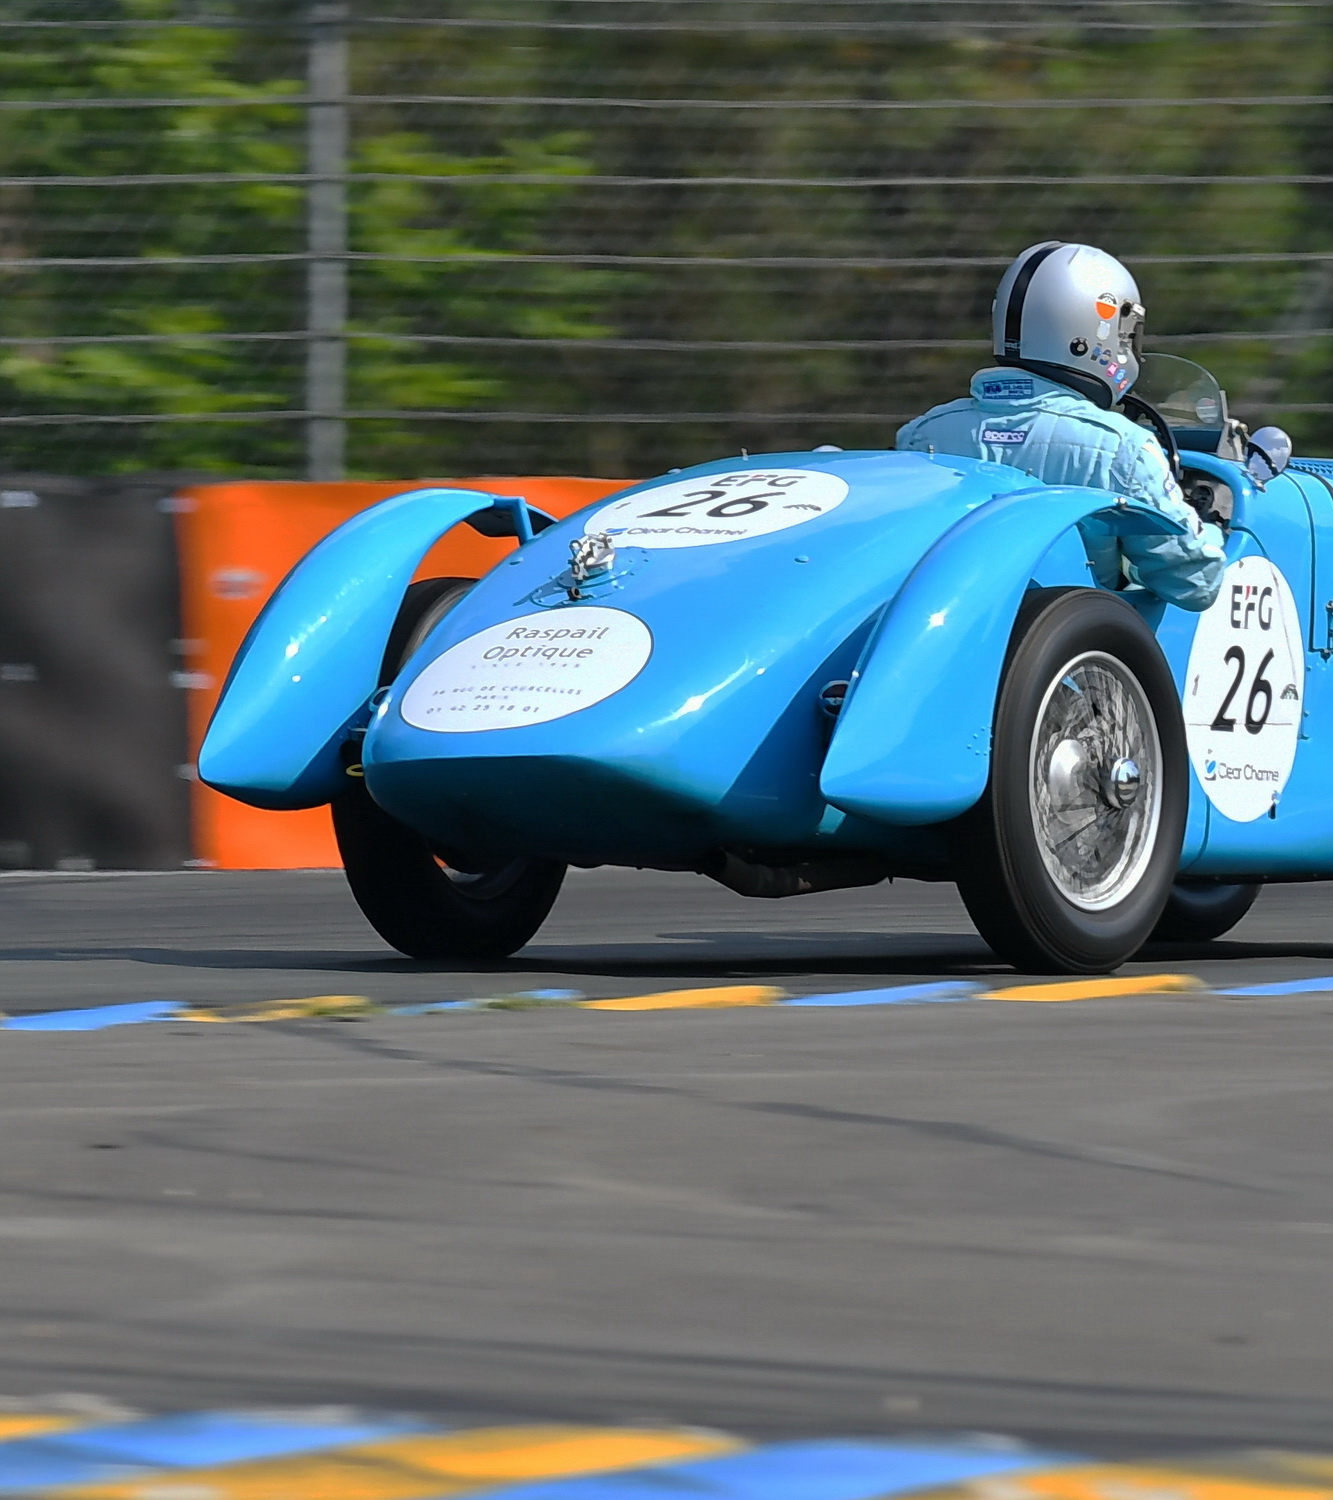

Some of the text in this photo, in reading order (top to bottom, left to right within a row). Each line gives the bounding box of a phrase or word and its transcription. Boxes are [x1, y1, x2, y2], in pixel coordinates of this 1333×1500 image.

[710, 474, 806, 488] EFG
[636, 490, 786, 518] 26
[1230, 585, 1273, 631] EFG
[506, 627, 609, 641] Raspail
[483, 644, 594, 661] Optique
[1210, 645, 1275, 735] 26
[1218, 762, 1280, 782] Cear Channe
